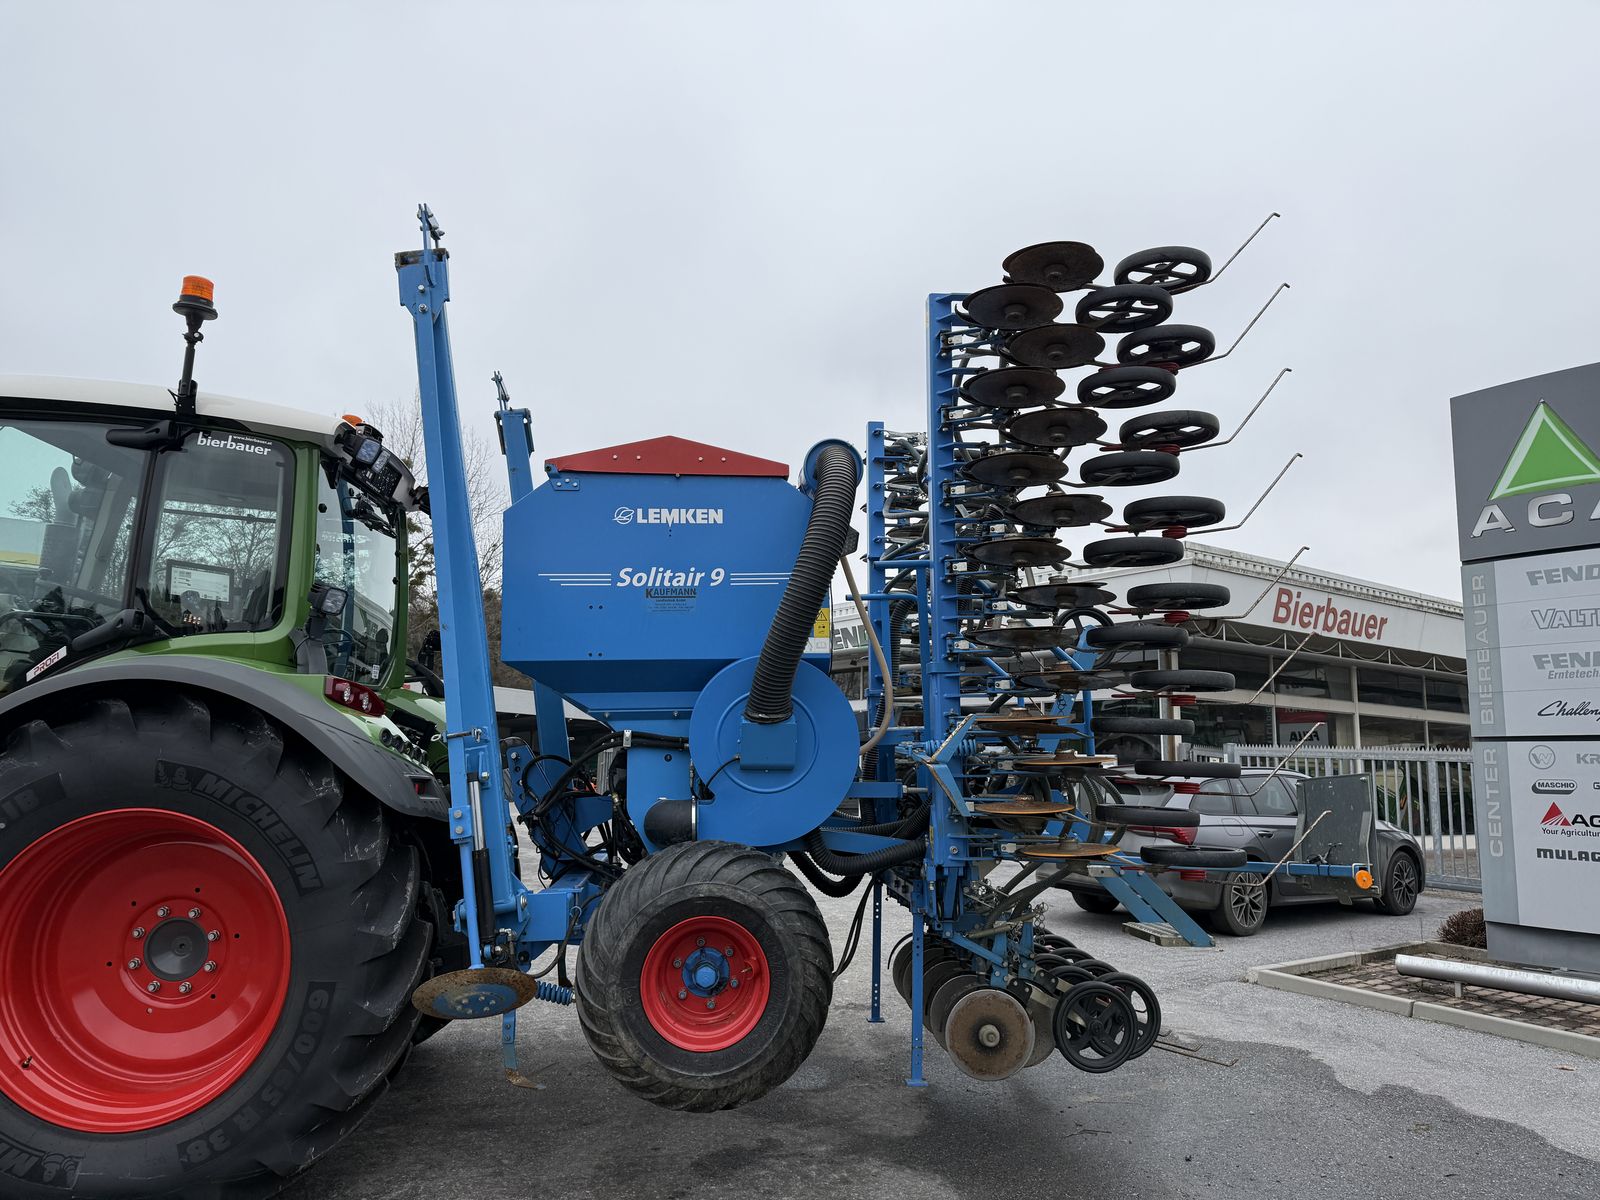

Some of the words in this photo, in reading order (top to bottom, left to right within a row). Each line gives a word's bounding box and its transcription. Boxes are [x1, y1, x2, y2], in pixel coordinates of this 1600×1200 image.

[197, 431, 272, 455] bierbauer
[636, 508, 724, 527] LEMKEN
[616, 566, 706, 587] Solitair
[710, 568, 725, 587] 9
[645, 587, 697, 598] KAUFMANN
[1273, 587, 1388, 640] Bierbauer
[1530, 608, 1600, 630] VALT
[1471, 574, 1495, 726] BIERBAUER
[33, 651, 60, 676] PROFI
[1548, 668, 1600, 680] Erntetech
[1483, 748, 1504, 858] CENTER
[197, 772, 320, 889] MICHELIN
[1541, 827, 1559, 836] Your
